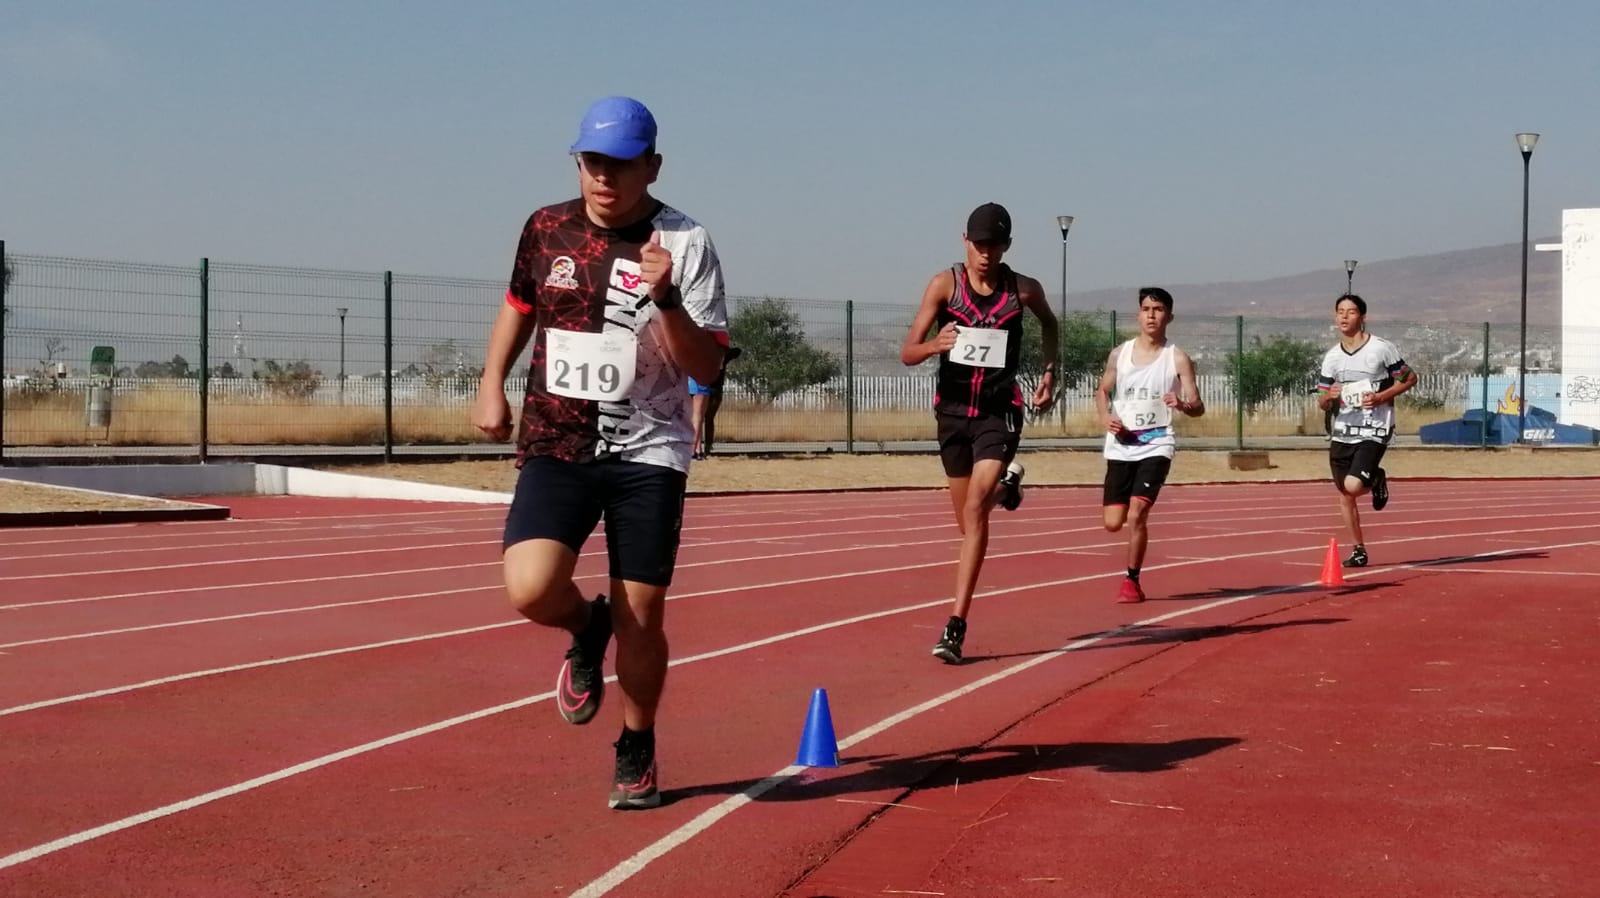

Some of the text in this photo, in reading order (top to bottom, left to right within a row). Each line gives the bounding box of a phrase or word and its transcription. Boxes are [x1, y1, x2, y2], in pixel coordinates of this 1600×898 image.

[963, 344, 991, 362] 27
[554, 359, 620, 394] 219
[1135, 412, 1157, 427] 52
